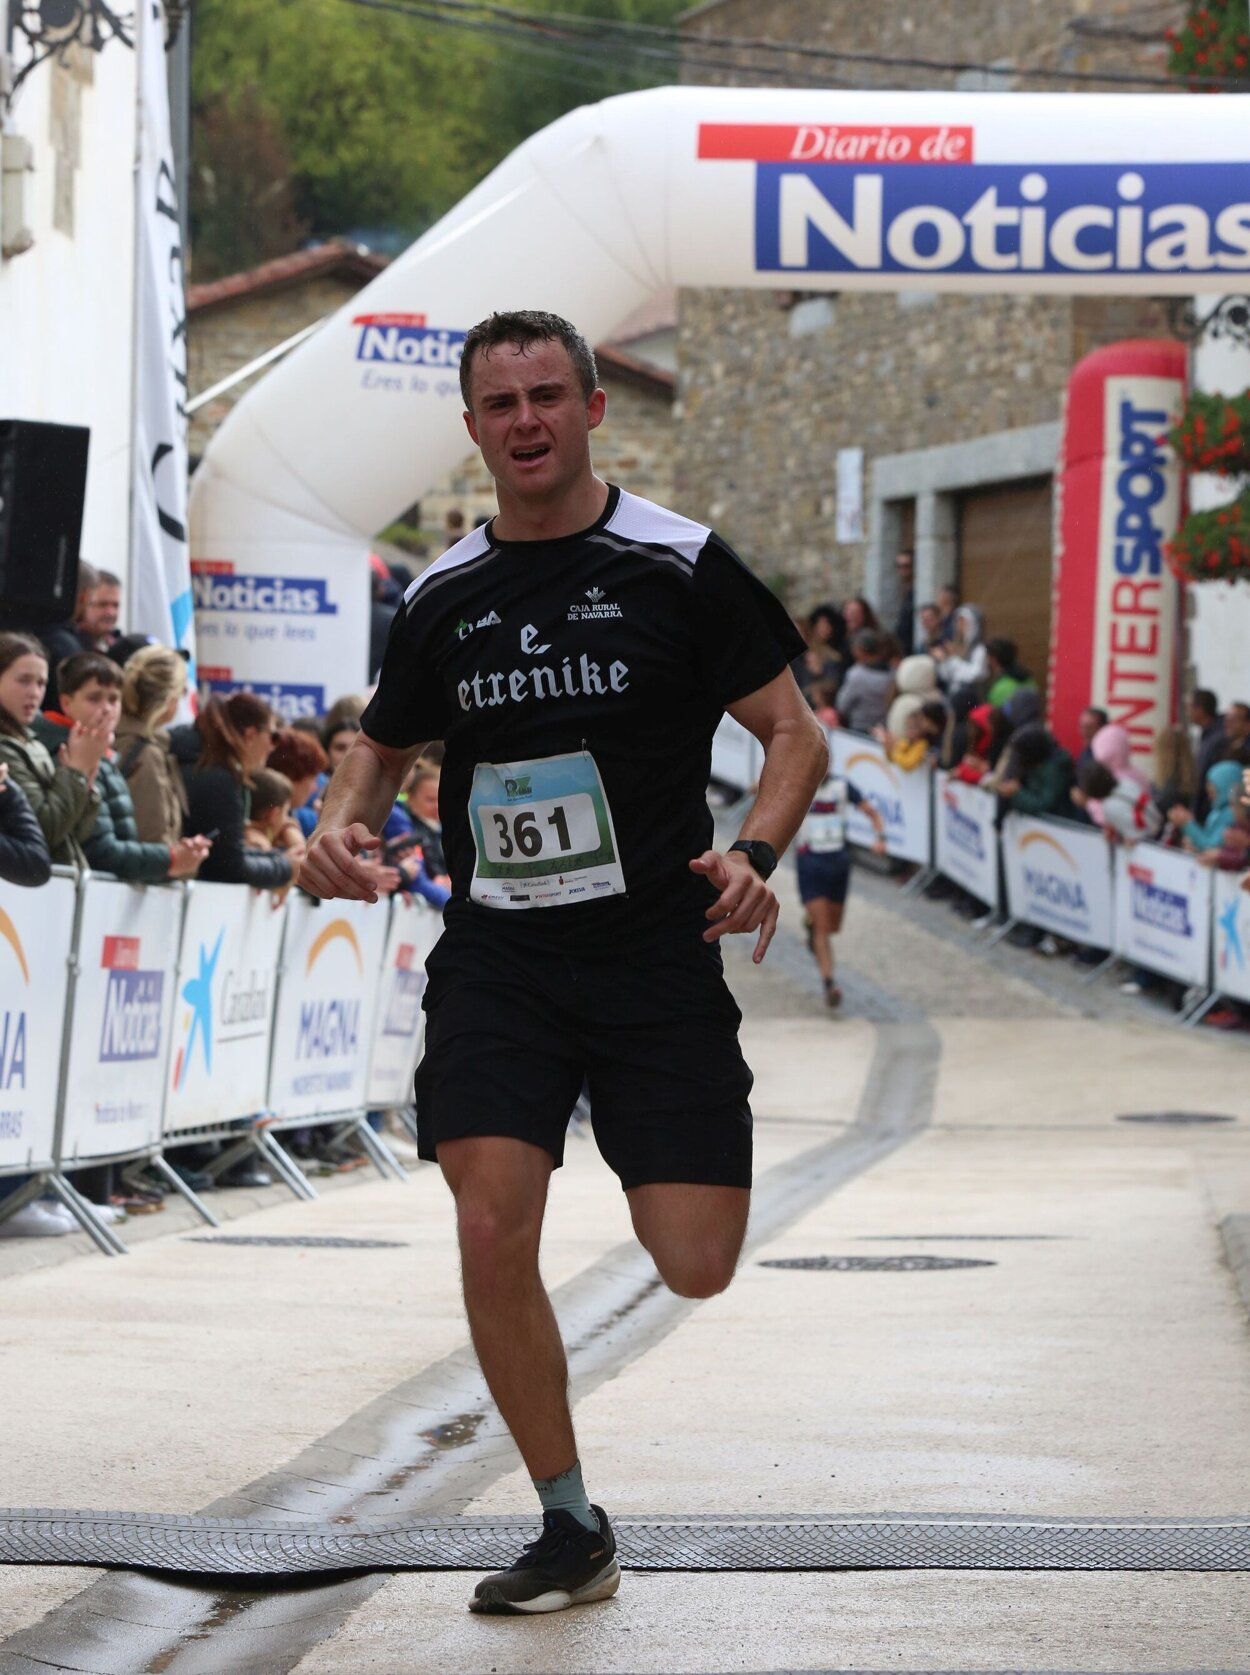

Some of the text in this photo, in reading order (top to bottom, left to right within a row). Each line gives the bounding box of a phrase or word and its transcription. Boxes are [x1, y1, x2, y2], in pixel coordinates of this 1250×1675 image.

[790, 127, 966, 160] Diario de
[779, 172, 1250, 271] Noticias
[193, 574, 319, 613] Noticias
[1109, 400, 1167, 754] INTERSPORT
[567, 610, 623, 621] DE NAVARRA
[570, 603, 620, 613] CAJA RURAL
[493, 806, 572, 858] 361
[295, 1000, 361, 1061] MAGNA
